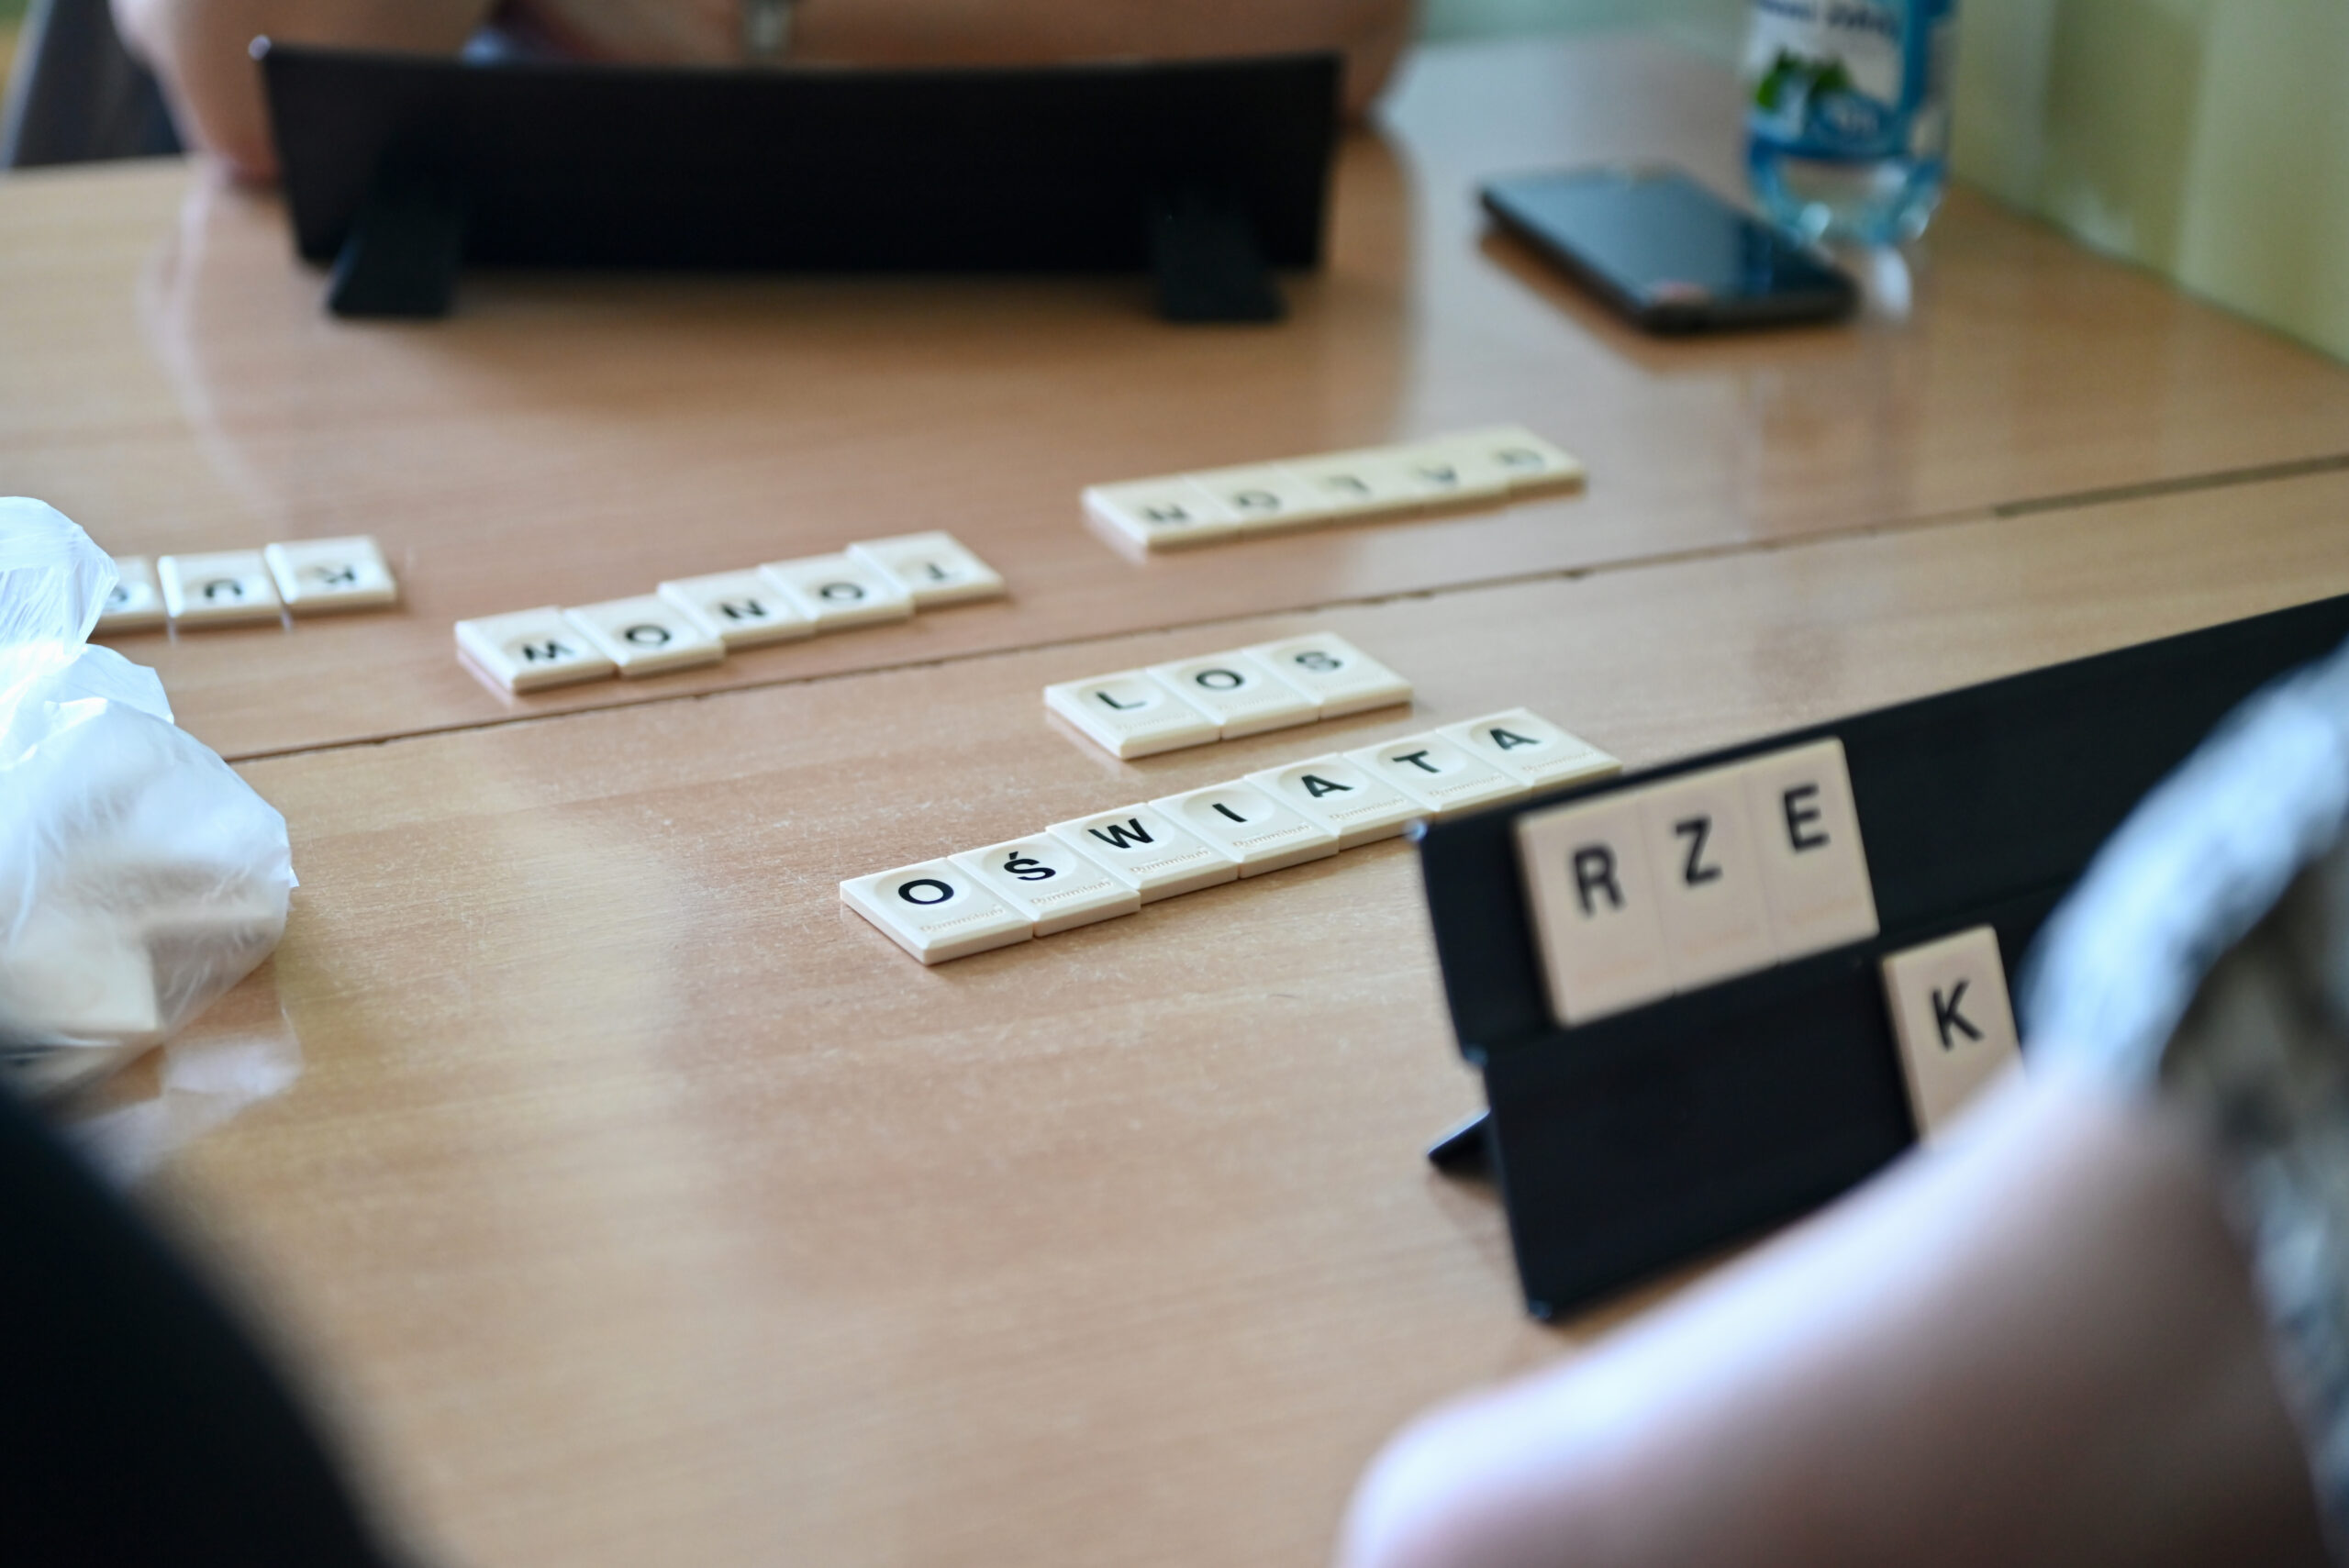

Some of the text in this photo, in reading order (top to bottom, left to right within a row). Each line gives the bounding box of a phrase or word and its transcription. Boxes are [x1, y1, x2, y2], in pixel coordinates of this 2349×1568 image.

[1095, 651, 1344, 710] LOS
[896, 727, 1543, 906] OŚWIATA
[1573, 783, 1831, 917] RZE
[1932, 979, 1985, 1052] K
